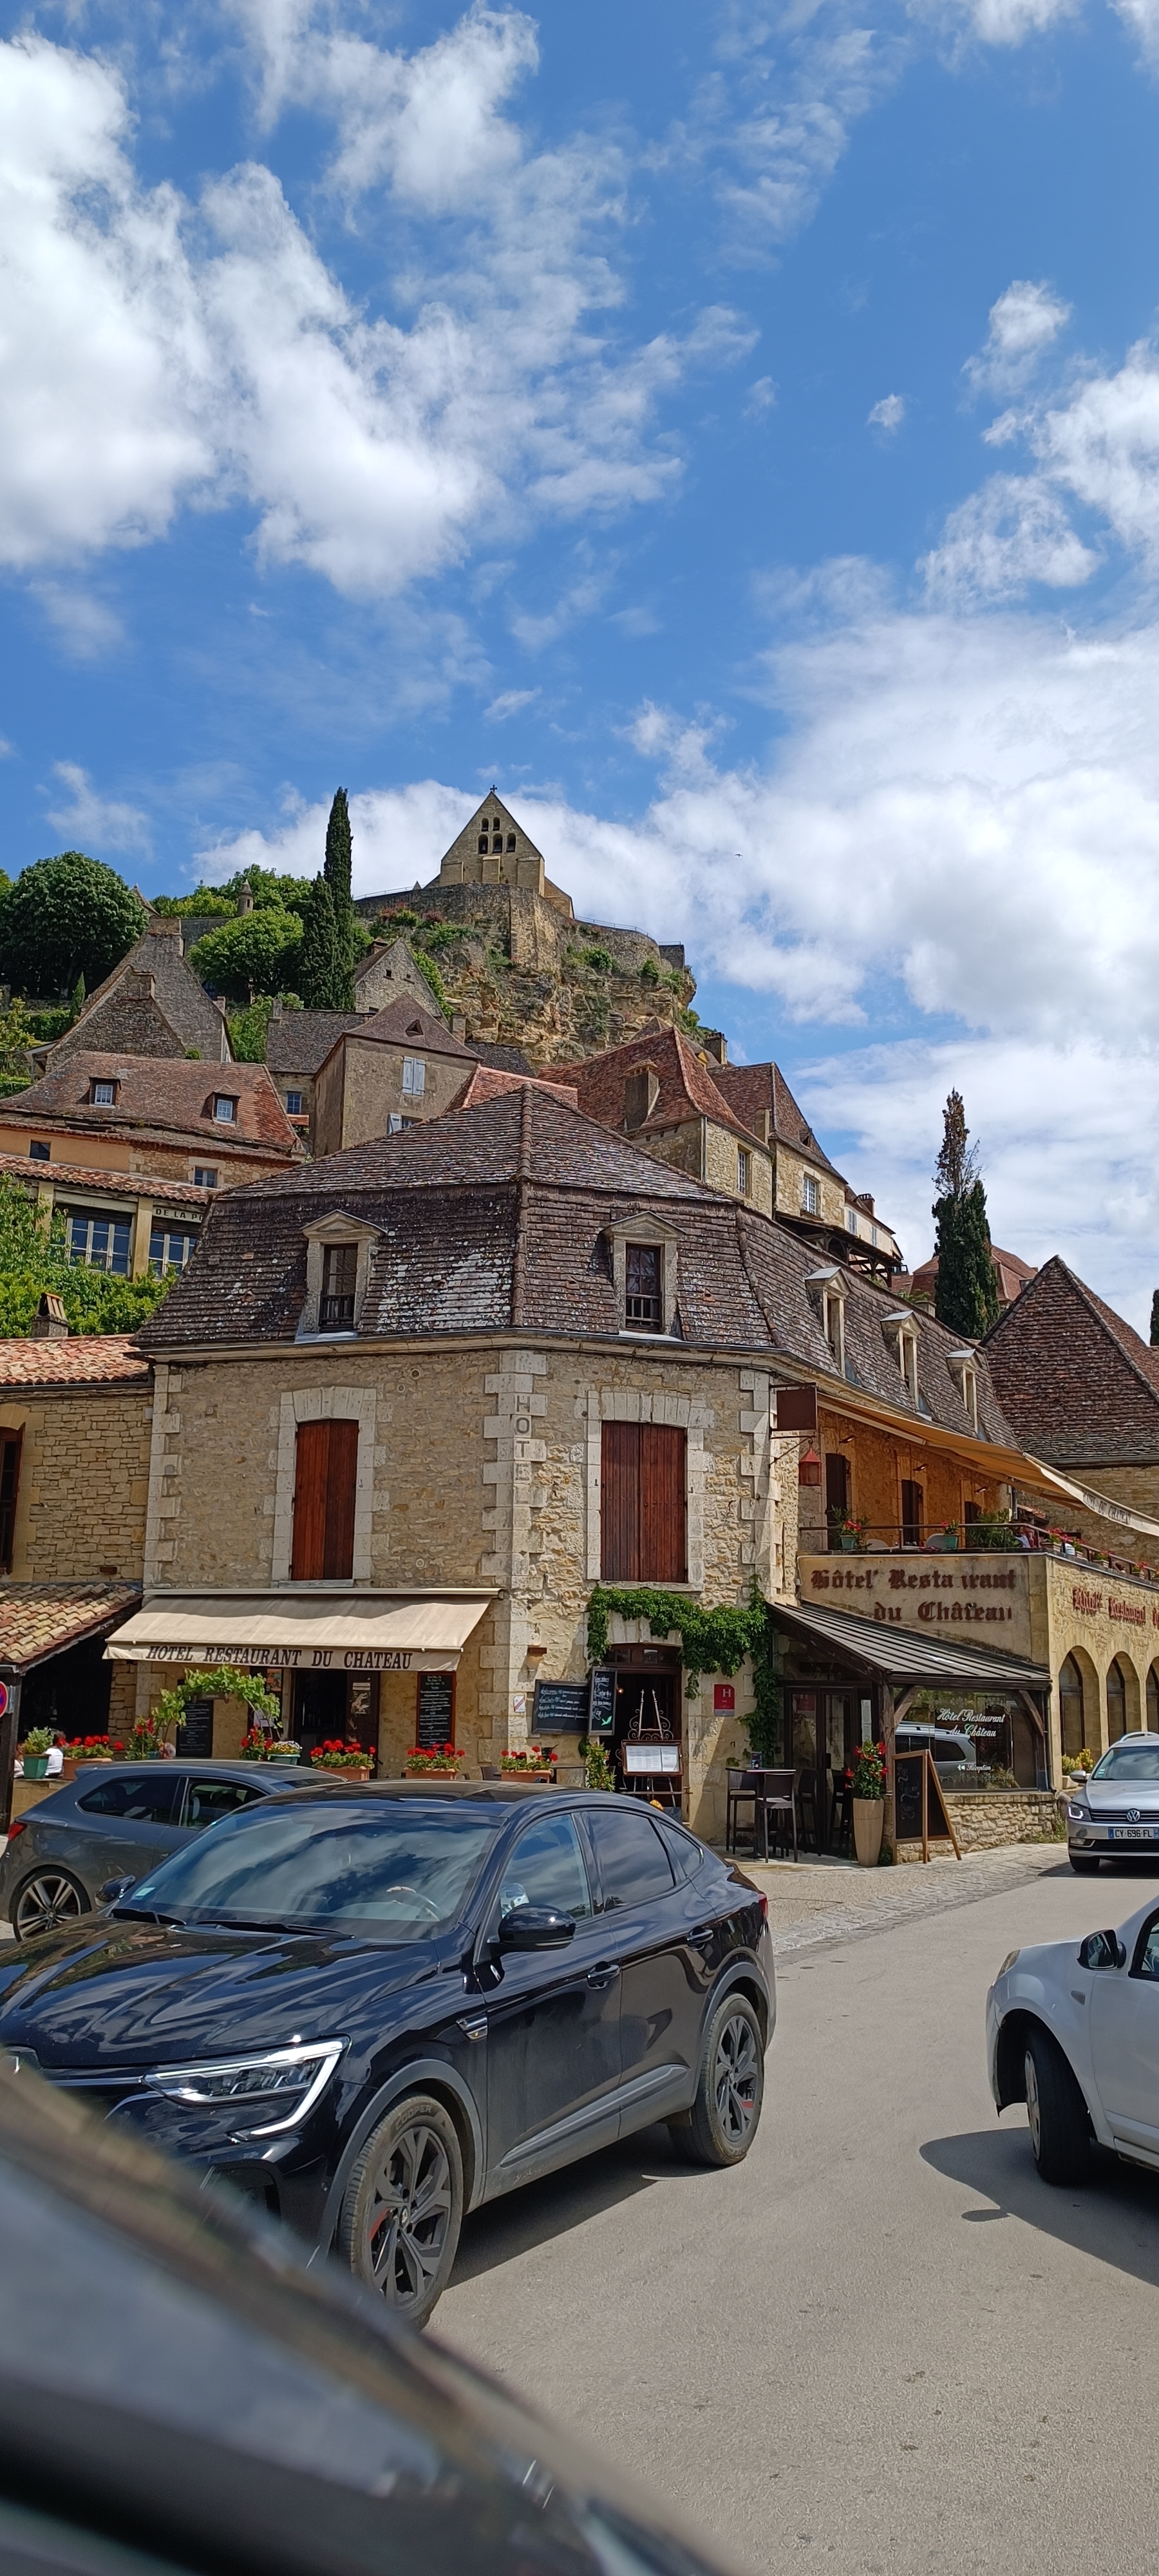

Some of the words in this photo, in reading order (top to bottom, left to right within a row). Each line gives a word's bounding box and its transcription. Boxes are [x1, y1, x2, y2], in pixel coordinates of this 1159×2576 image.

[811, 1569, 873, 1589] Hôtel
[873, 1602, 902, 1621] du
[146, 1645, 193, 1661] HOTEL
[203, 1646, 302, 1666] RESTAURANT
[311, 1650, 334, 1667] DU
[344, 1651, 413, 1669] CHATEAU
[722, 1689, 731, 1698] H
[937, 1708, 960, 1722] Hôtel
[961, 1709, 1006, 1723] Restaurant
[950, 1725, 961, 1736] du
[964, 1723, 997, 1737] Château
[395, 2105, 433, 2131] COOPER
